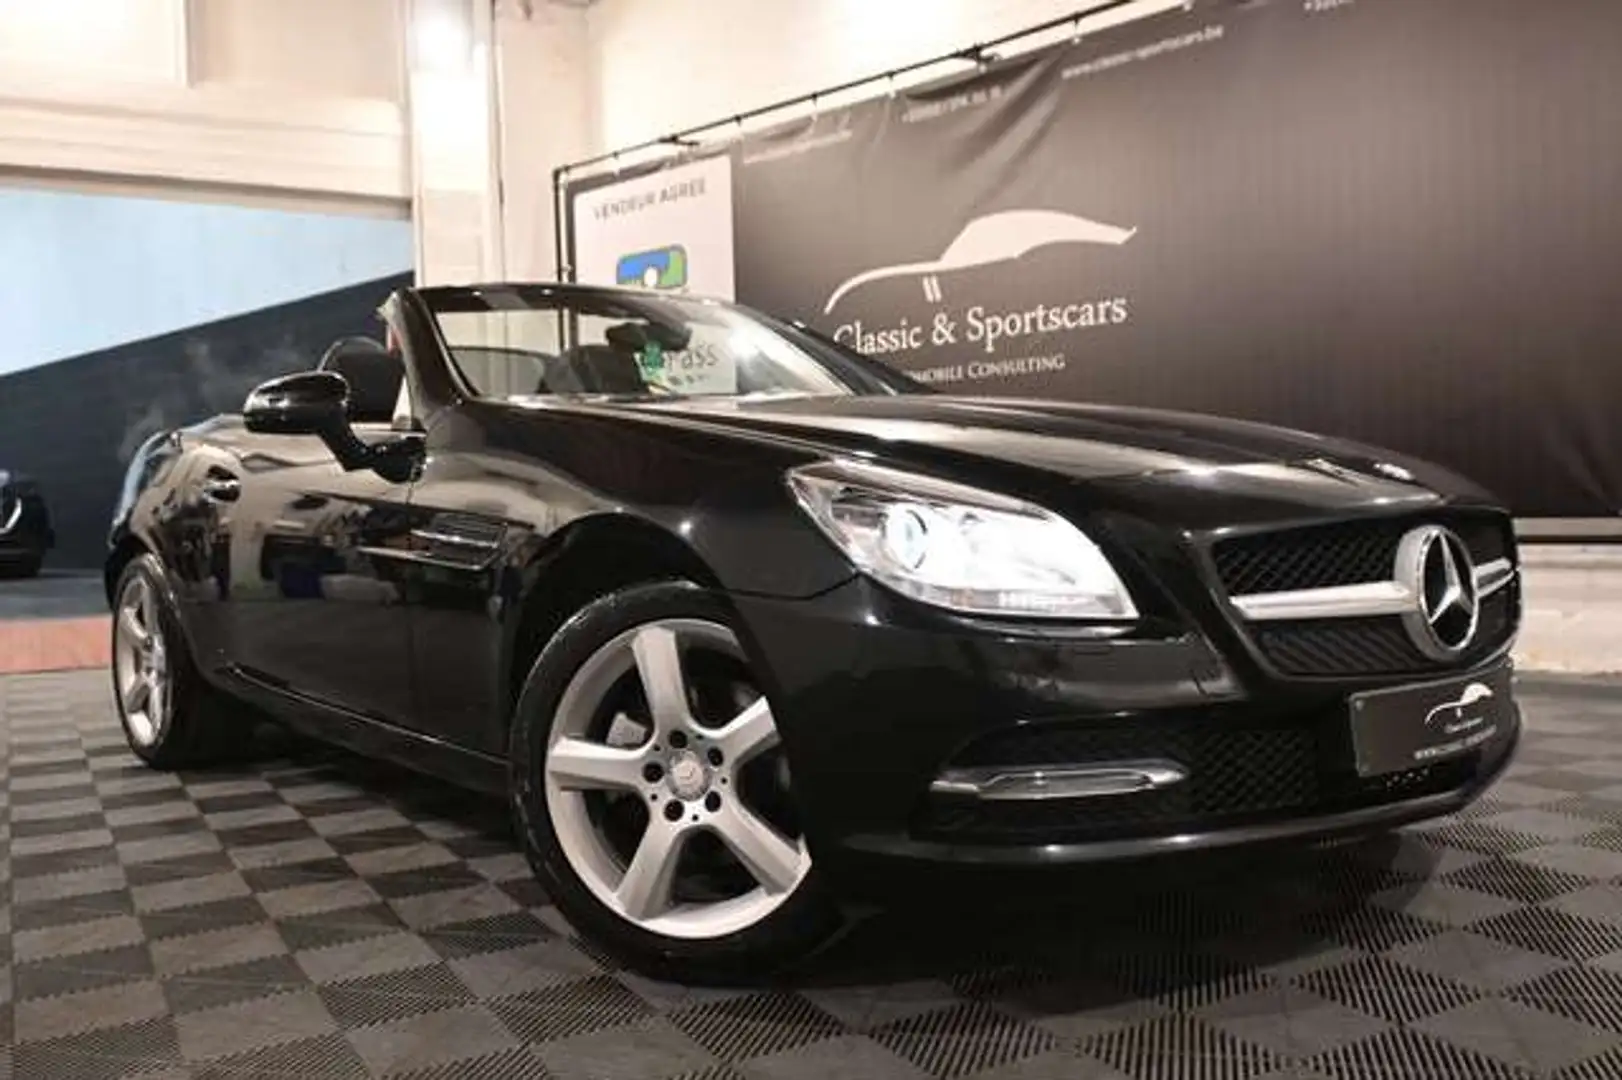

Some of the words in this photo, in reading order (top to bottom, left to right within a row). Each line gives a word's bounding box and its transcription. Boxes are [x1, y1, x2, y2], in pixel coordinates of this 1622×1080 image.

[833, 318, 923, 354] Classic
[932, 312, 957, 346] &
[966, 297, 1127, 352] Sportscars
